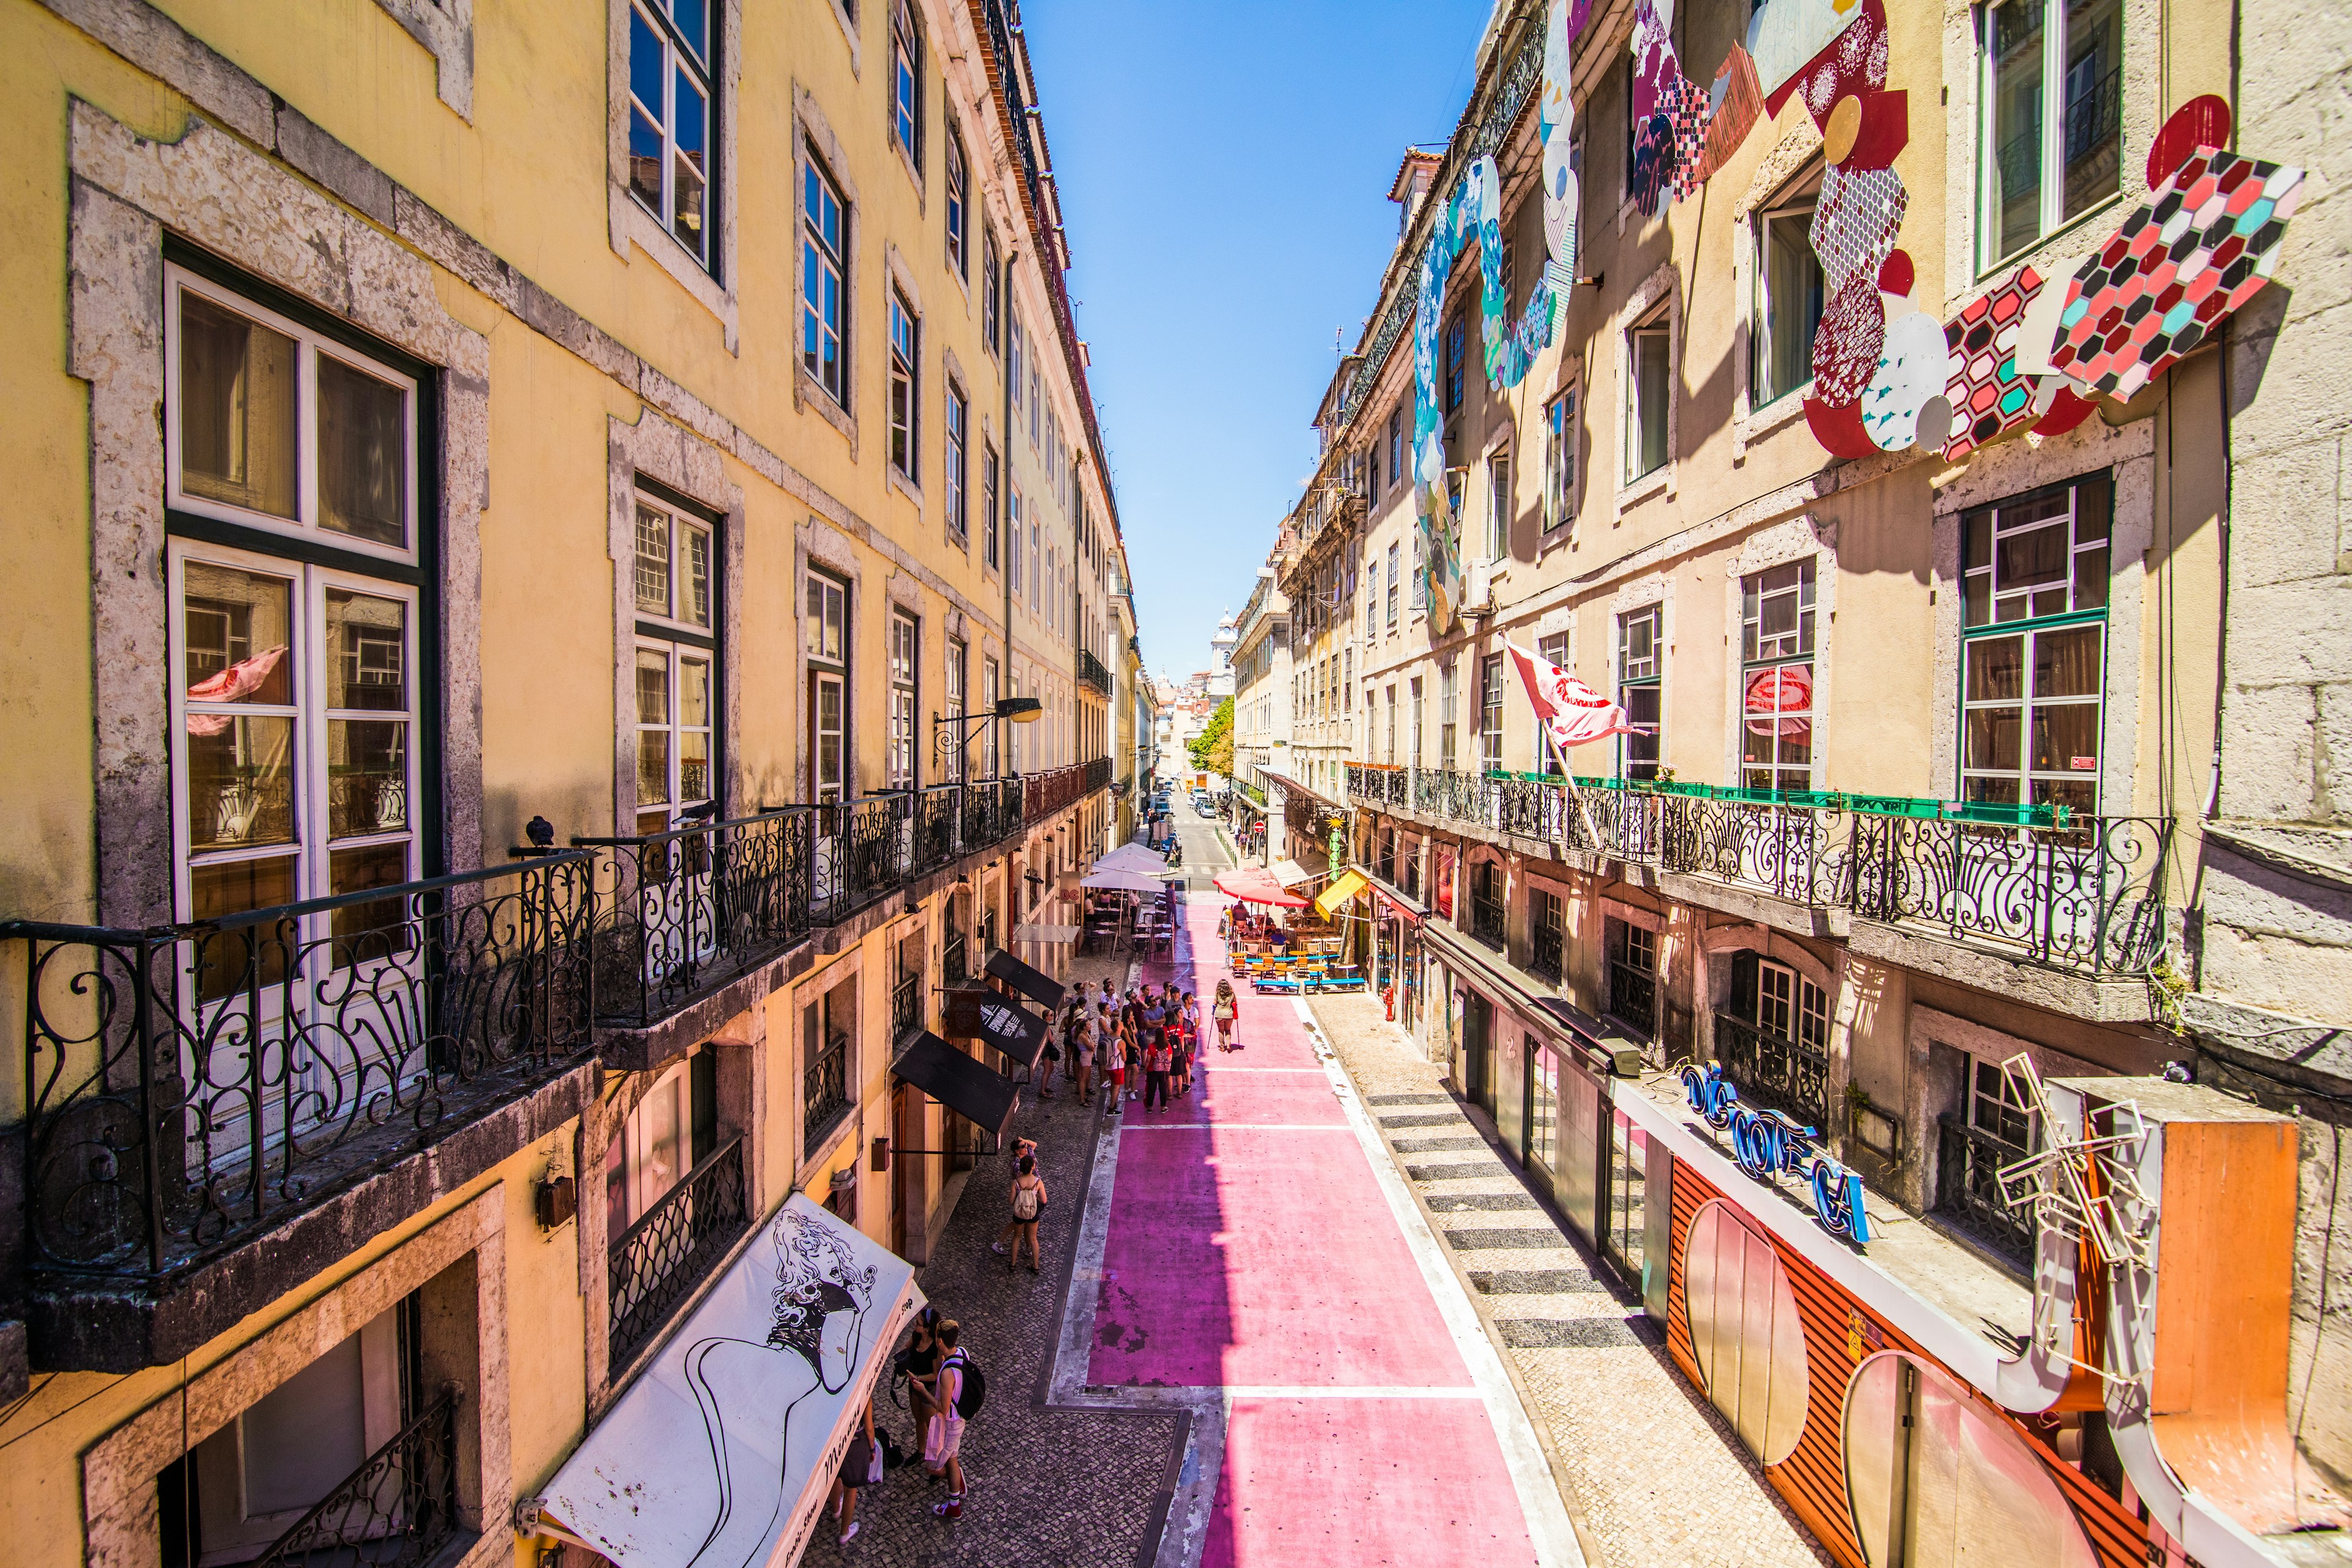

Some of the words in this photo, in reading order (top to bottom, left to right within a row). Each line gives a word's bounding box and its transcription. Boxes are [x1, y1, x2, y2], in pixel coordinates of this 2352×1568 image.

[1061, 889, 1079, 900] BC
[824, 1403, 861, 1487] Ménage
[785, 1531, 802, 1568] Erotic
[804, 1499, 818, 1533] Show
[2146, 1540, 2166, 1568] 30
